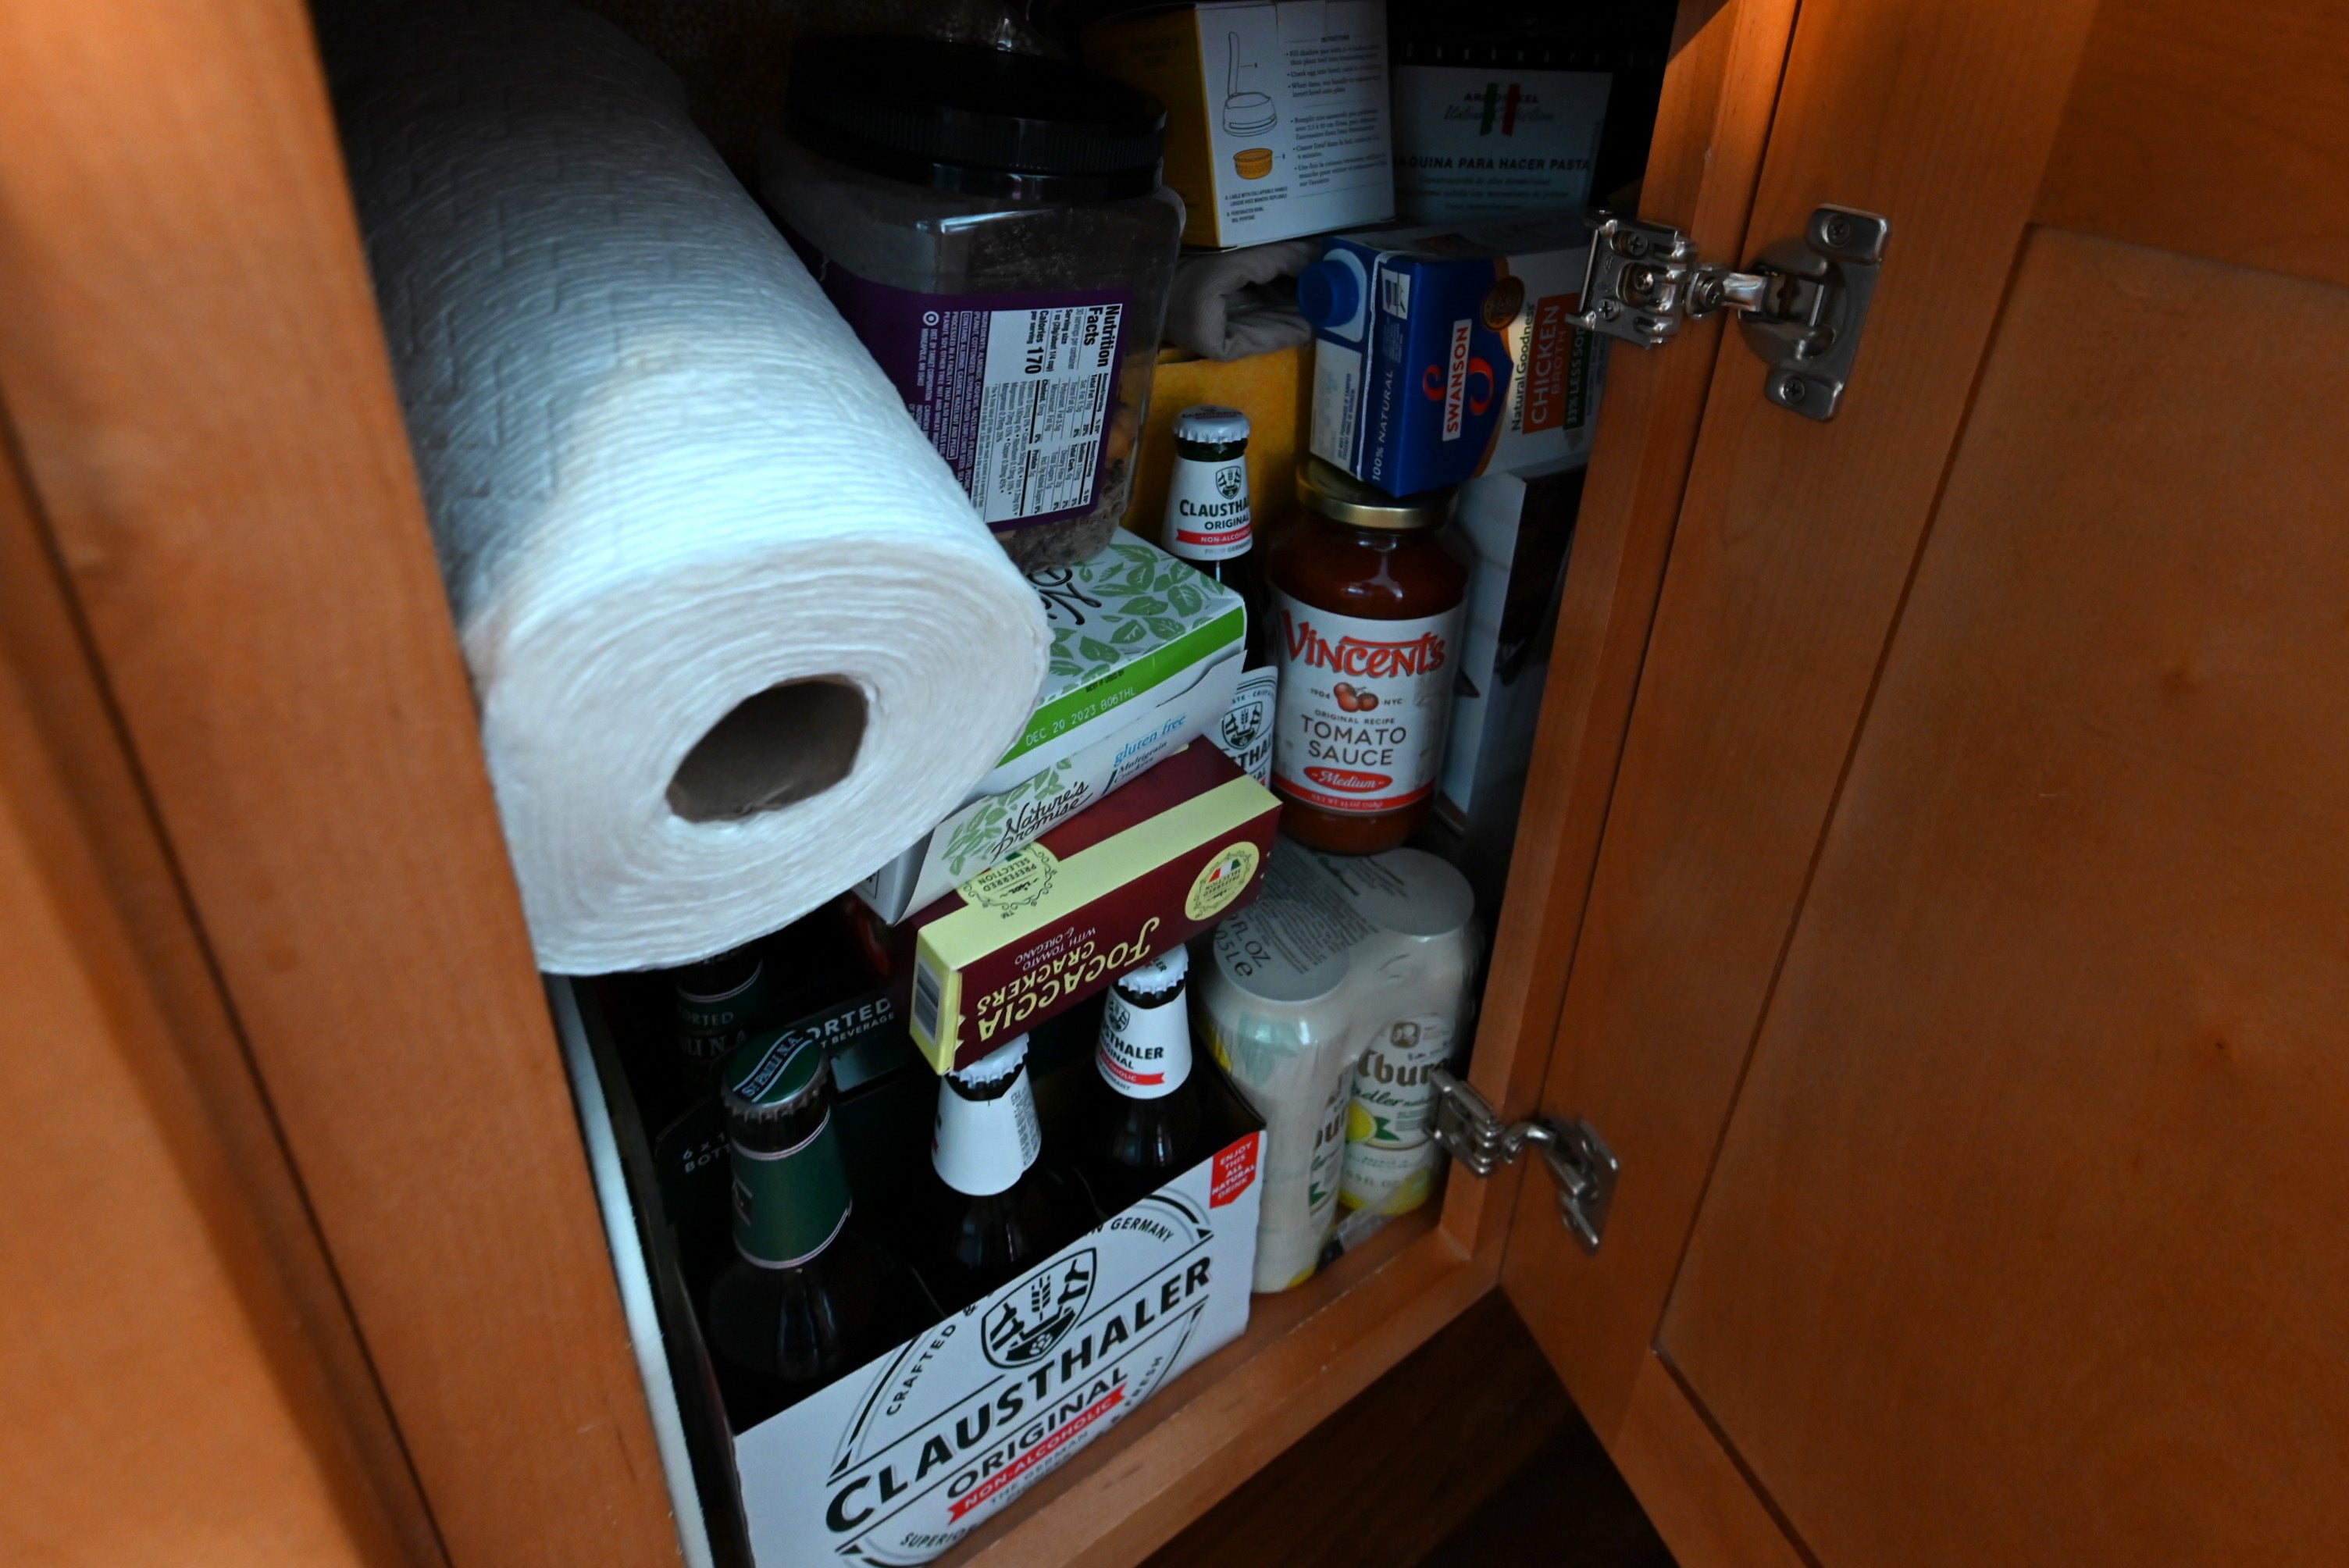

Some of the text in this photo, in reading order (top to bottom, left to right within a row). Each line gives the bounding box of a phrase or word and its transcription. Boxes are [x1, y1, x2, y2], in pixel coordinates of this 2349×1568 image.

[1459, 159, 1495, 169] PARA
[1499, 159, 1545, 170] HACER
[1550, 159, 1591, 171] PASTA
[1026, 322, 1035, 344] serving
[1061, 309, 1072, 331] Serving
[1083, 307, 1103, 345] Facts
[1096, 305, 1120, 367] Nutrition
[1024, 310, 1049, 374] Calories 170
[1068, 347, 1078, 369] container
[1070, 337, 1078, 346] per
[1089, 374, 1097, 388] Total
[1447, 326, 1468, 433] SWANSON
[1511, 304, 1535, 430] Natural Goodness
[1531, 305, 1561, 424] CHICKEN
[1551, 330, 1567, 394] BROTH
[1371, 370, 1393, 481] 100% NATURAL
[1026, 727, 1046, 747] DEC
[1053, 719, 1065, 733] 20
[1071, 704, 1096, 725] 2023
[1301, 715, 1406, 746] TOMATO
[1315, 709, 1359, 724] ORIGINAL
[1114, 715, 1186, 768] gluten free
[1119, 742, 1167, 772] Multigrain
[1309, 740, 1393, 767] SAUCE
[1319, 770, 1377, 789] Medium
[991, 792, 1093, 864] Promise
[1004, 781, 1089, 837] Nature's
[978, 857, 1031, 886] SELECTION
[983, 864, 1037, 892] PREFERRED
[1014, 926, 1075, 965] & OREGANO
[1022, 927, 1096, 971] WITH TOMATO
[1245, 941, 1271, 968] OZ
[977, 940, 1096, 1016] CRACKERS
[978, 917, 1160, 1042] FOCACCIA
[831, 1012, 896, 1045] BEVERAGE
[1220, 1140, 1253, 1166] ENJOY
[1225, 1153, 1246, 1171] THIS
[1226, 1164, 1243, 1179] ALL
[1211, 1164, 1256, 1196] NATURAL
[1218, 1175, 1248, 1199] DRINK
[887, 1324, 956, 1417] CRAFTED
[1110, 1217, 1174, 1243] GERMANY
[826, 1256, 1213, 1534] CLAUSTHALER
[947, 1367, 1128, 1499] ORIGINAL
[964, 1399, 1114, 1509] NON-ALCOHOLIC
[1025, 1431, 1089, 1480] GERMAN
